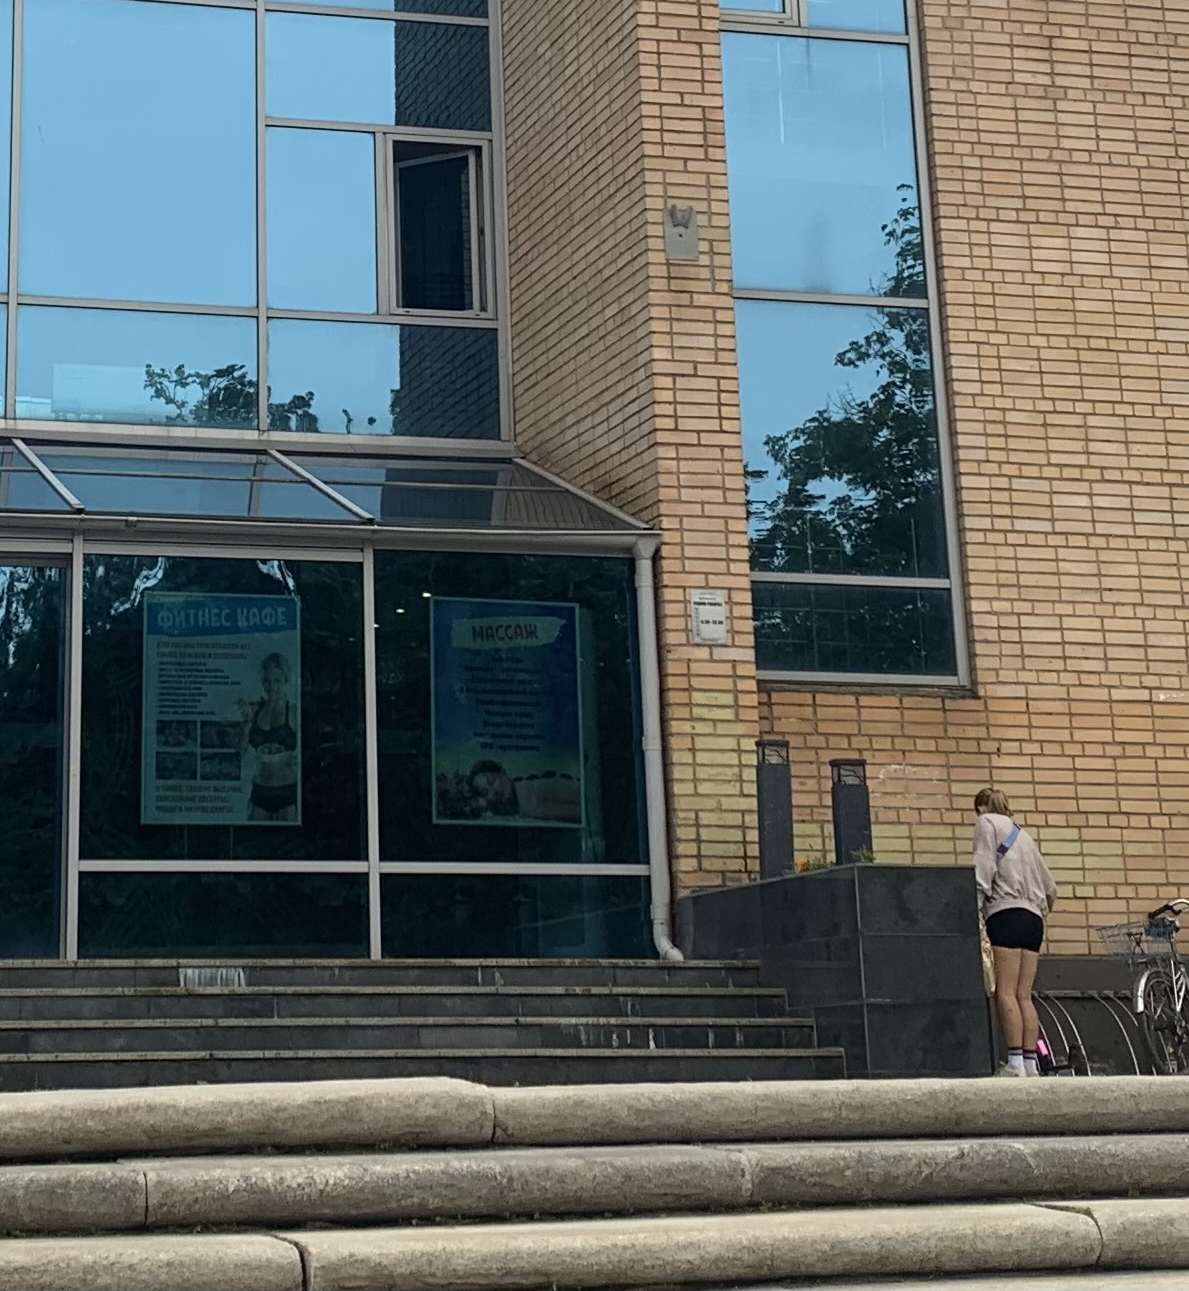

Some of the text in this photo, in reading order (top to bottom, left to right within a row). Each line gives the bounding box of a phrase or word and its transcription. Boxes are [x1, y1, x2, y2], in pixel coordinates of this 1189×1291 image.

[157, 606, 287, 630] ФИТНЕС КАФЕ
[471, 623, 538, 641] МАССАЖ
